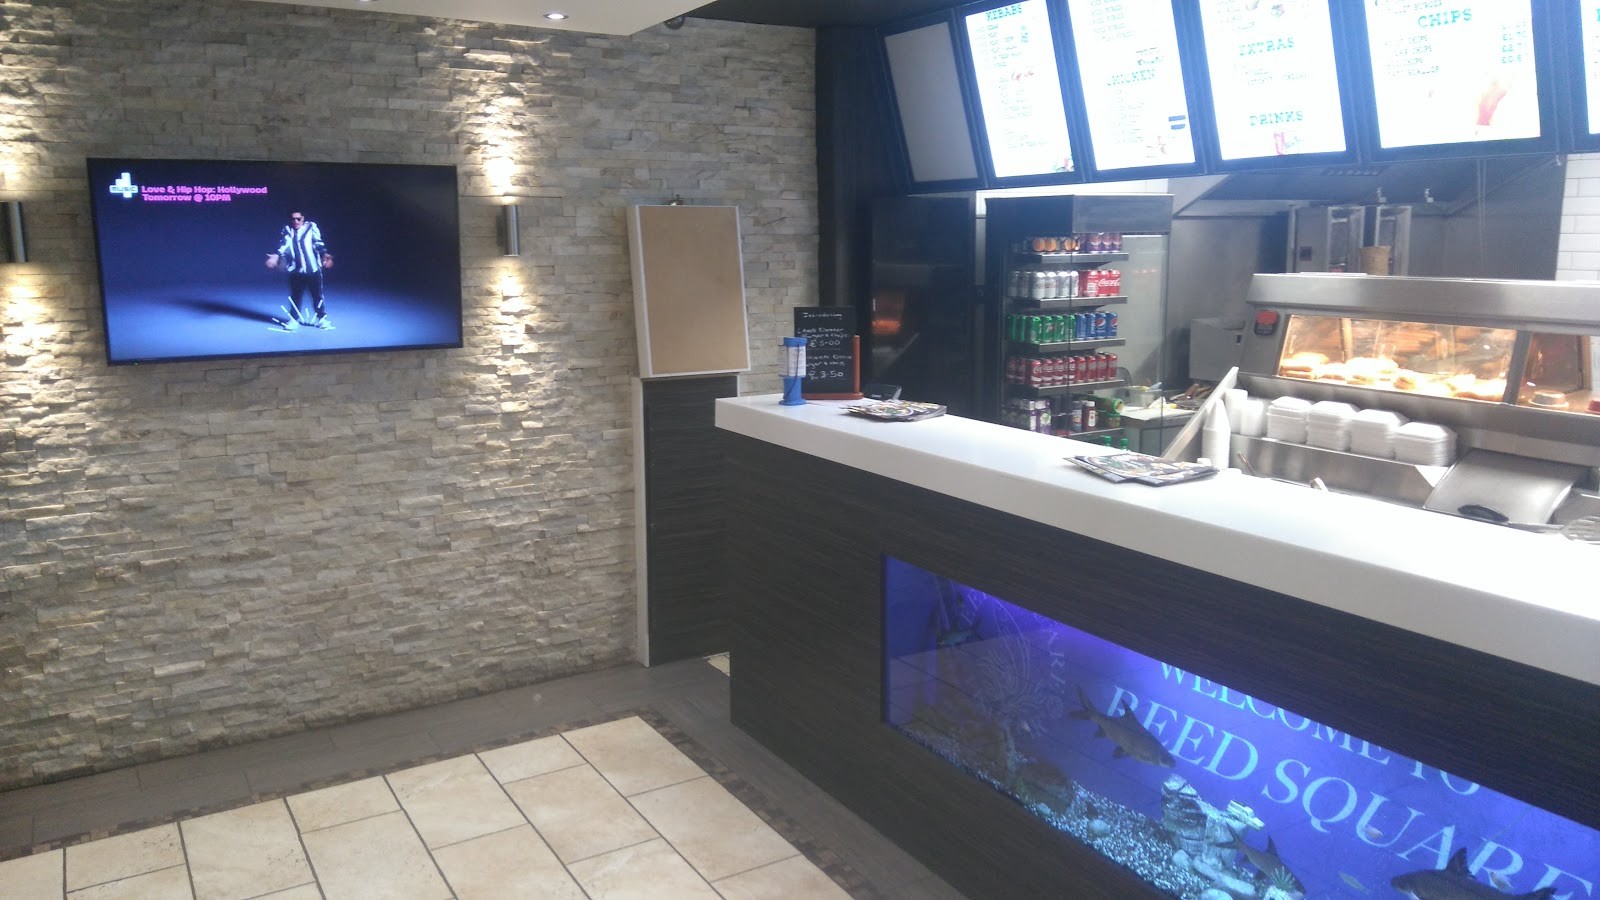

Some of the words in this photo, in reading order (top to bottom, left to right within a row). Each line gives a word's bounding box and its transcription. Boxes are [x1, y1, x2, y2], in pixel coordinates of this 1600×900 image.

[1417, 8, 1473, 28] CHIPS
[1238, 37, 1295, 57] EXTRAS
[1249, 110, 1304, 127] DRINKS
[167, 186, 175, 194] &
[176, 186, 192, 194] Hip
[194, 186, 215, 194] Hop:
[217, 186, 267, 194] Hollywood
[193, 194, 203, 202] @
